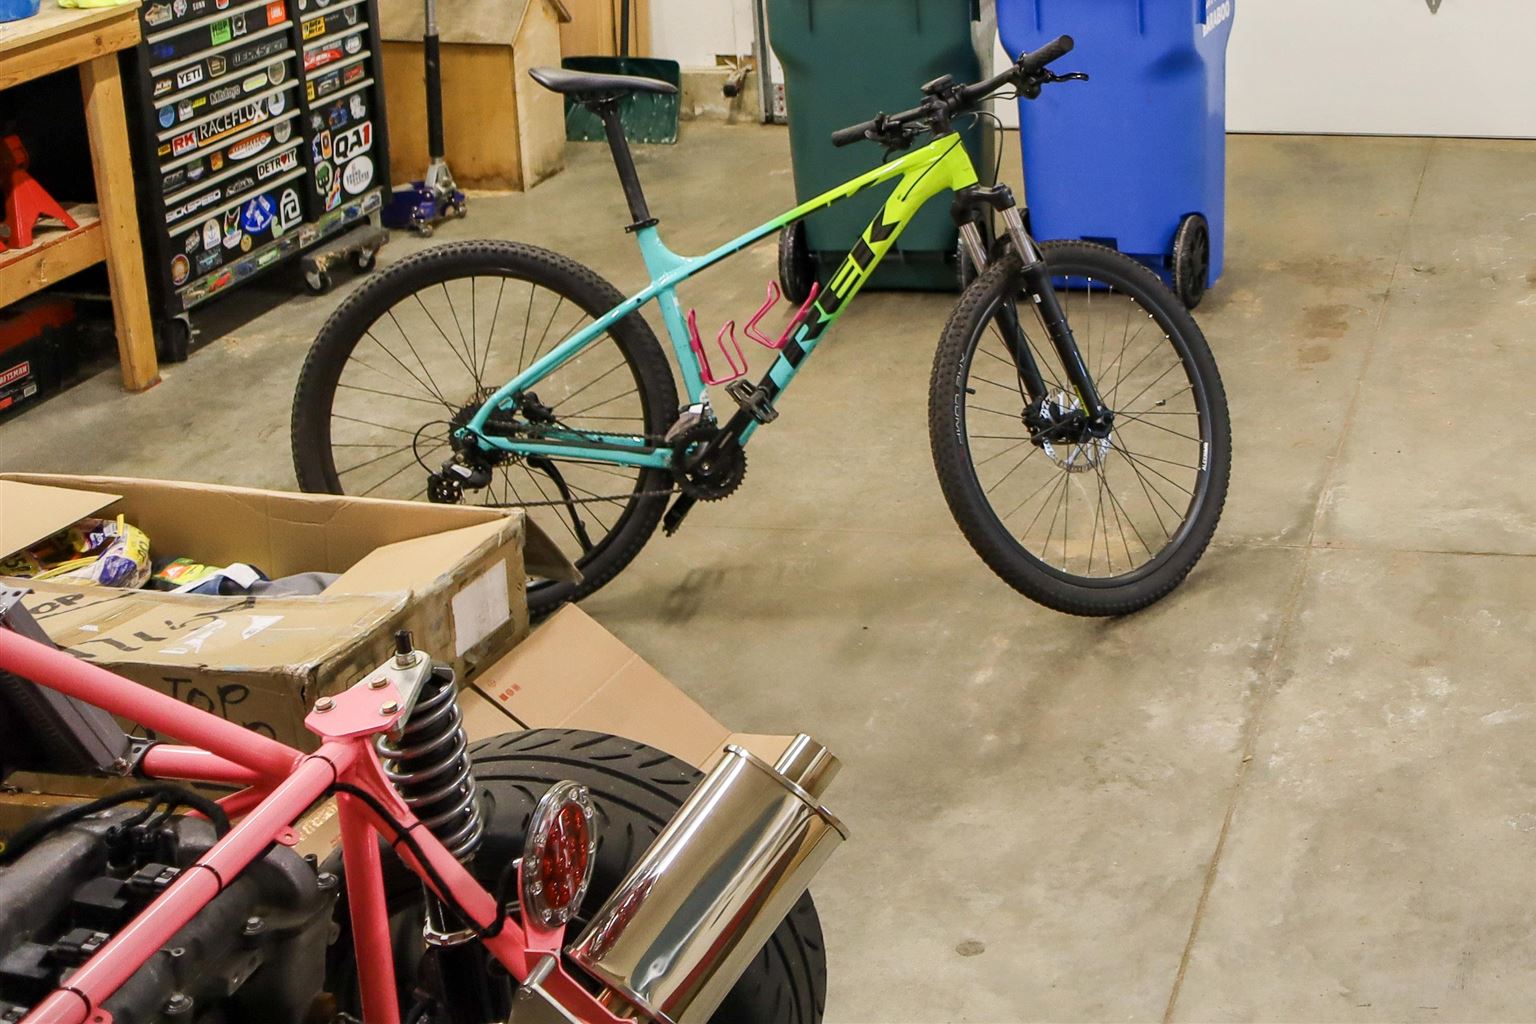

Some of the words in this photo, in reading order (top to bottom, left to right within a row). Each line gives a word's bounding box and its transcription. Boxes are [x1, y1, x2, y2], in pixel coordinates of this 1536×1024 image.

[178, 70, 202, 85] YETI
[200, 97, 267, 140] RACEFLUX
[173, 131, 196, 151] RK
[335, 123, 370, 159] QA1
[30, 592, 85, 616] OP
